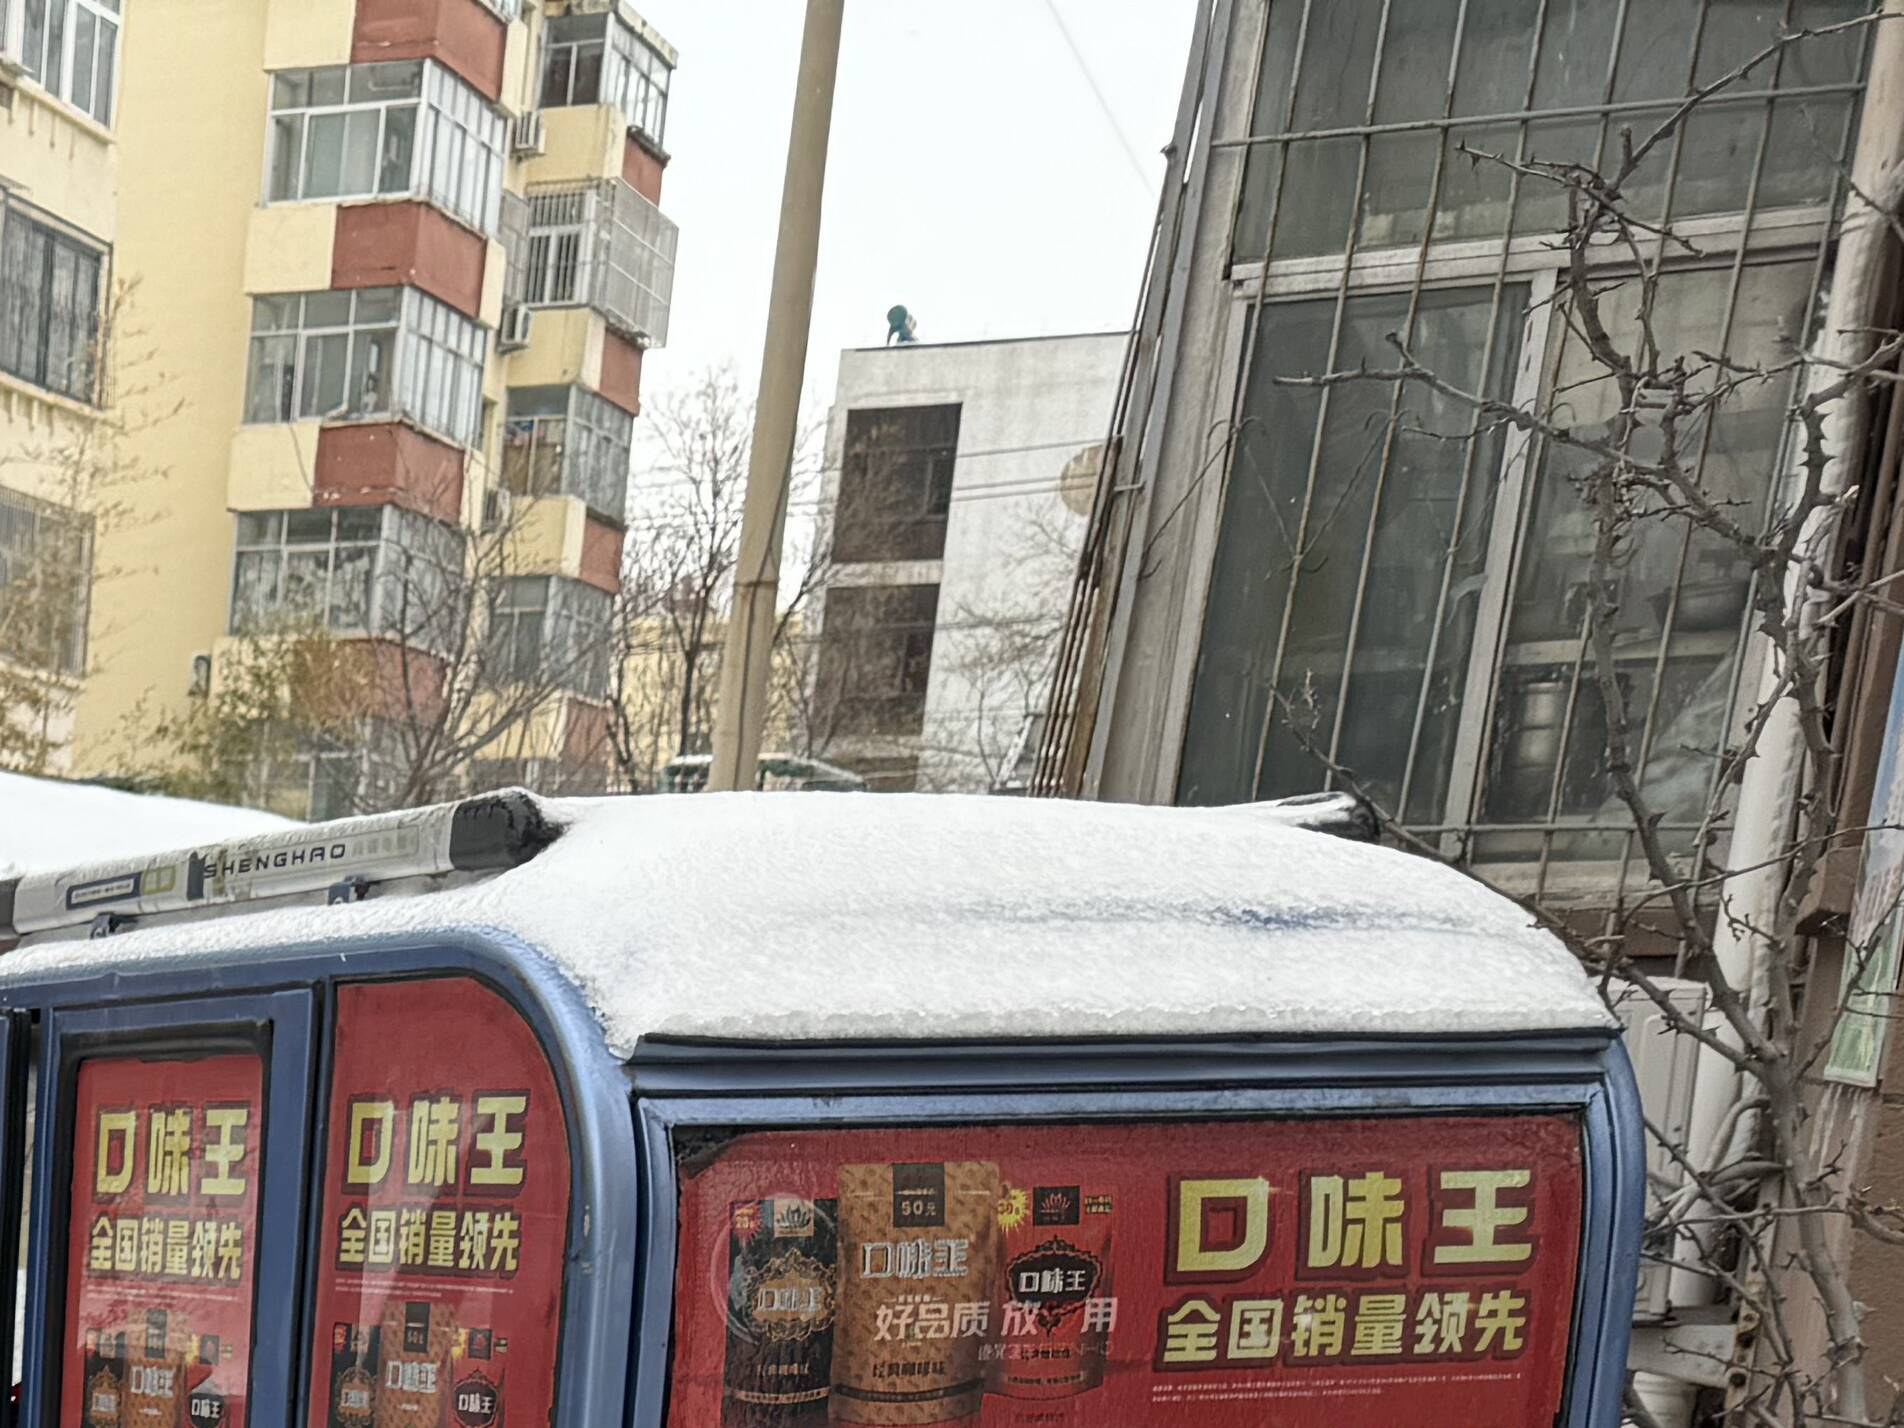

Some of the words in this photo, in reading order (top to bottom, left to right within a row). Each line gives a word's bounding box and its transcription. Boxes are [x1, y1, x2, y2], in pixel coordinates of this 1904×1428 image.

[202, 842, 347, 880] SHENGHAO
[96, 1108, 249, 1196] 口味王
[347, 1096, 527, 1187] 口味王
[90, 1215, 243, 1281] 全国销量领先
[339, 1207, 520, 1272] 全国销量领先
[1176, 1168, 1533, 1273] 口味王
[1018, 1267, 1087, 1294] 口味王
[873, 1300, 991, 1341] 好品质
[1163, 1289, 1527, 1363] 全国销量领先
[457, 1392, 493, 1414] 口味王
